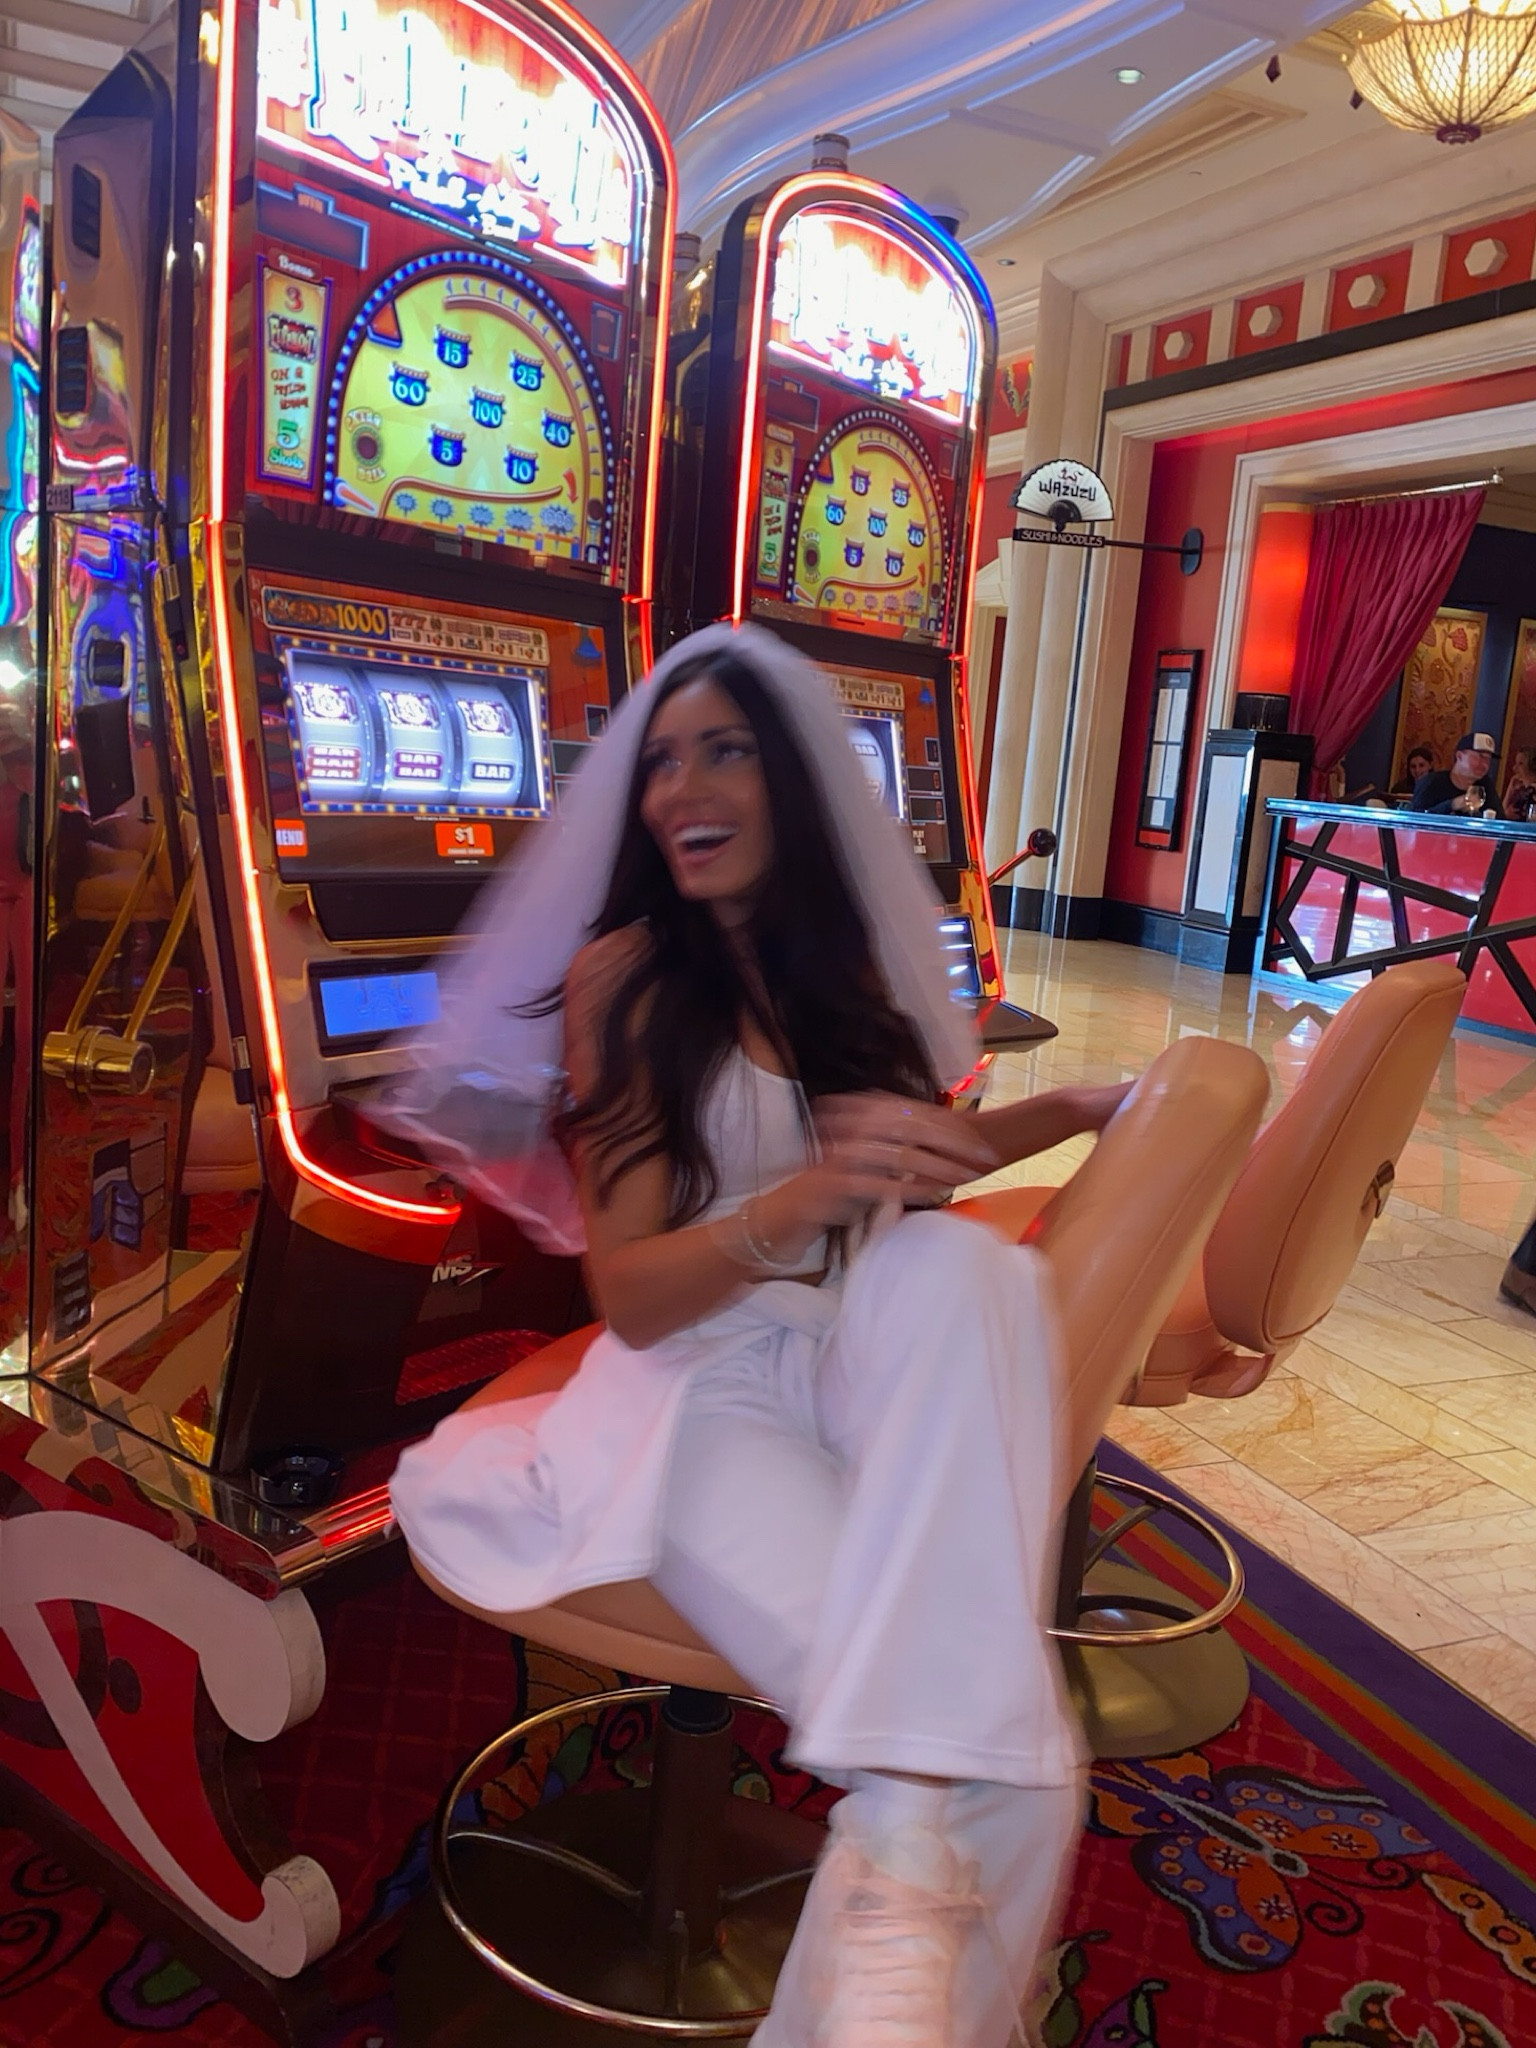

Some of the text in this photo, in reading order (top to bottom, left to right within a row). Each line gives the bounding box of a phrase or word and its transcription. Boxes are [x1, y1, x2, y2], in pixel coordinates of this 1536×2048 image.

[285, 286, 304, 312] 3
[443, 342, 462, 365] 15
[516, 364, 539, 388] 25
[395, 376, 425, 404] 60
[475, 400, 502, 427] 100
[276, 418, 300, 450] 5
[546, 422, 570, 449] 40
[441, 440, 454, 462] 5
[512, 458, 532, 481] 10
[854, 476, 867, 495] 15
[1038, 478, 1097, 502] WAZUZU
[895, 488, 908, 506] 25
[827, 505, 844, 523] 60
[869, 516, 886, 536] 100
[909, 530, 922, 547] 40
[1021, 530, 1050, 541] SUSHI
[1059, 533, 1103, 546] NOODLES
[849, 549, 858, 566] 5
[889, 558, 902, 576] 10
[336, 604, 386, 635] 1000
[400, 753, 438, 765] BAR
[474, 764, 511, 779] BAR
[454, 826, 475, 847] $1
